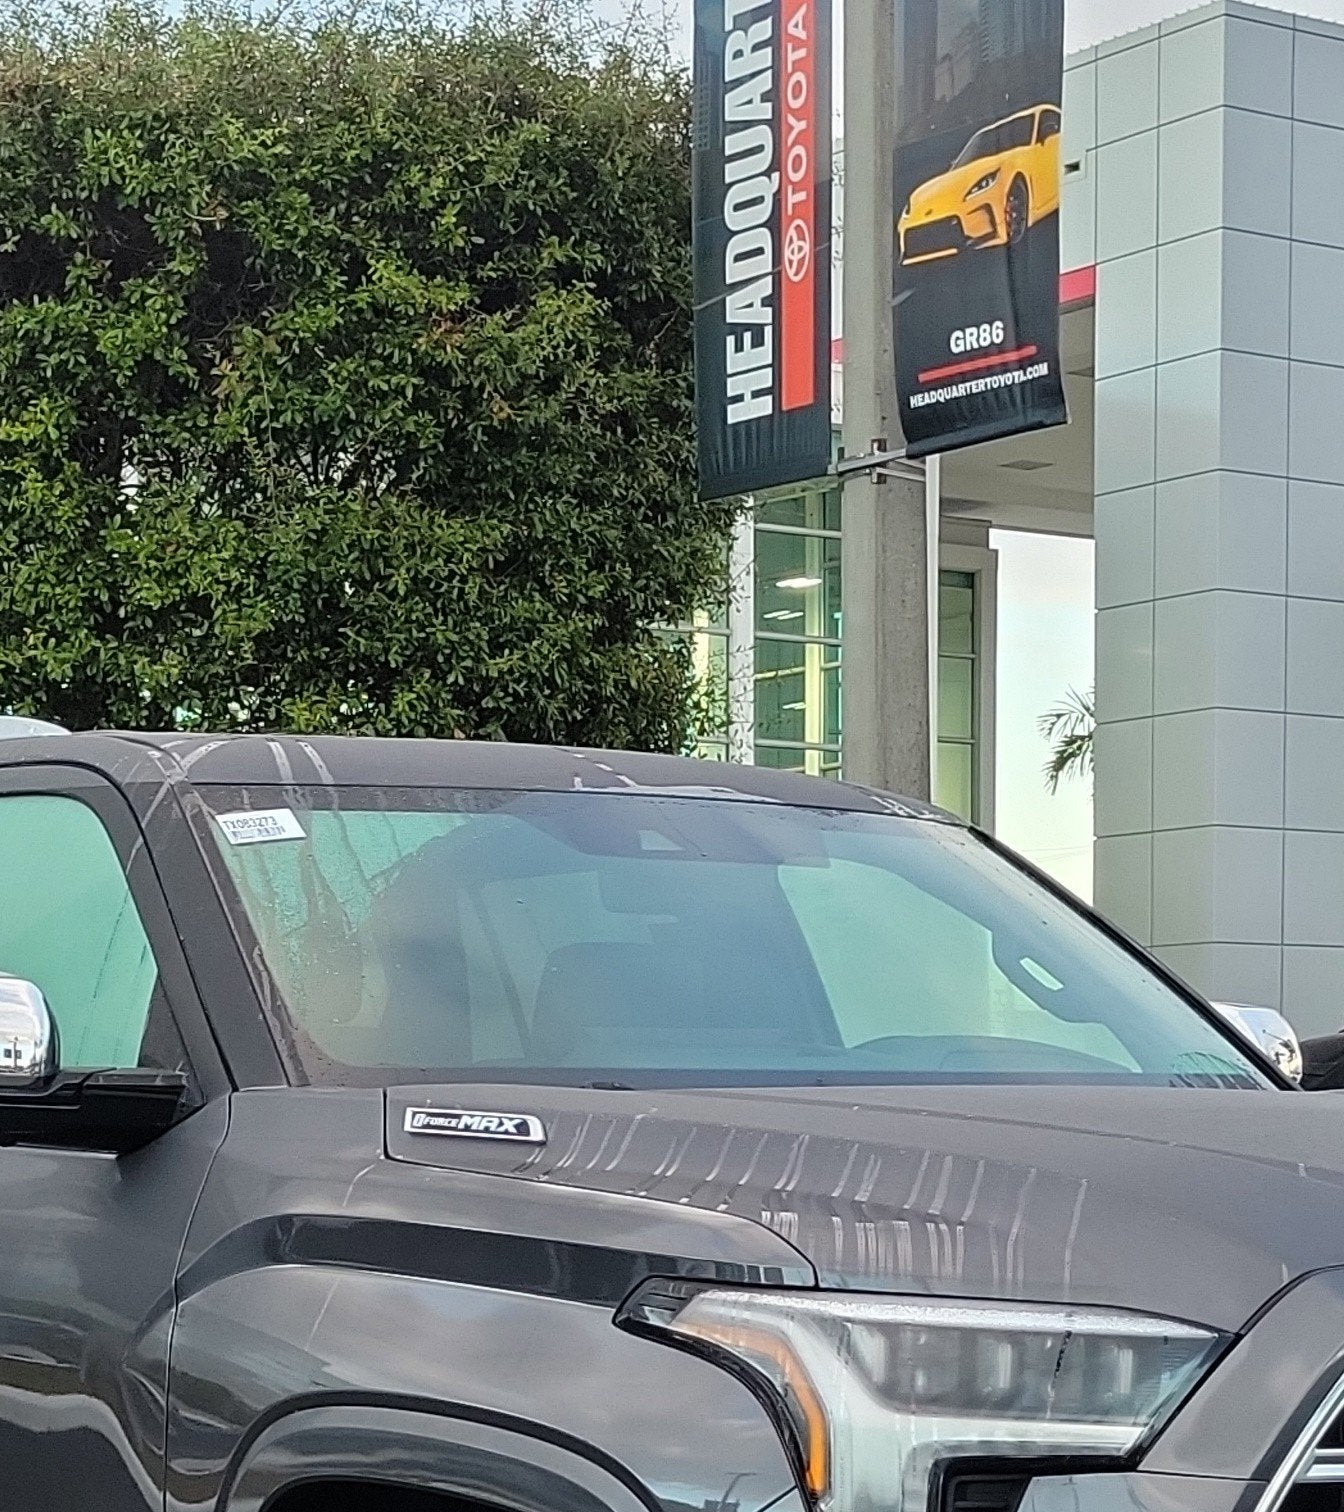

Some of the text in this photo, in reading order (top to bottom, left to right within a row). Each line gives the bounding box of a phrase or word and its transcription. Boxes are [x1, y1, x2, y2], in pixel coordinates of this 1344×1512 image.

[786, 3, 808, 215] TOYOTA
[949, 320, 1004, 354] GR86
[458, 1115, 523, 1133] MAX
